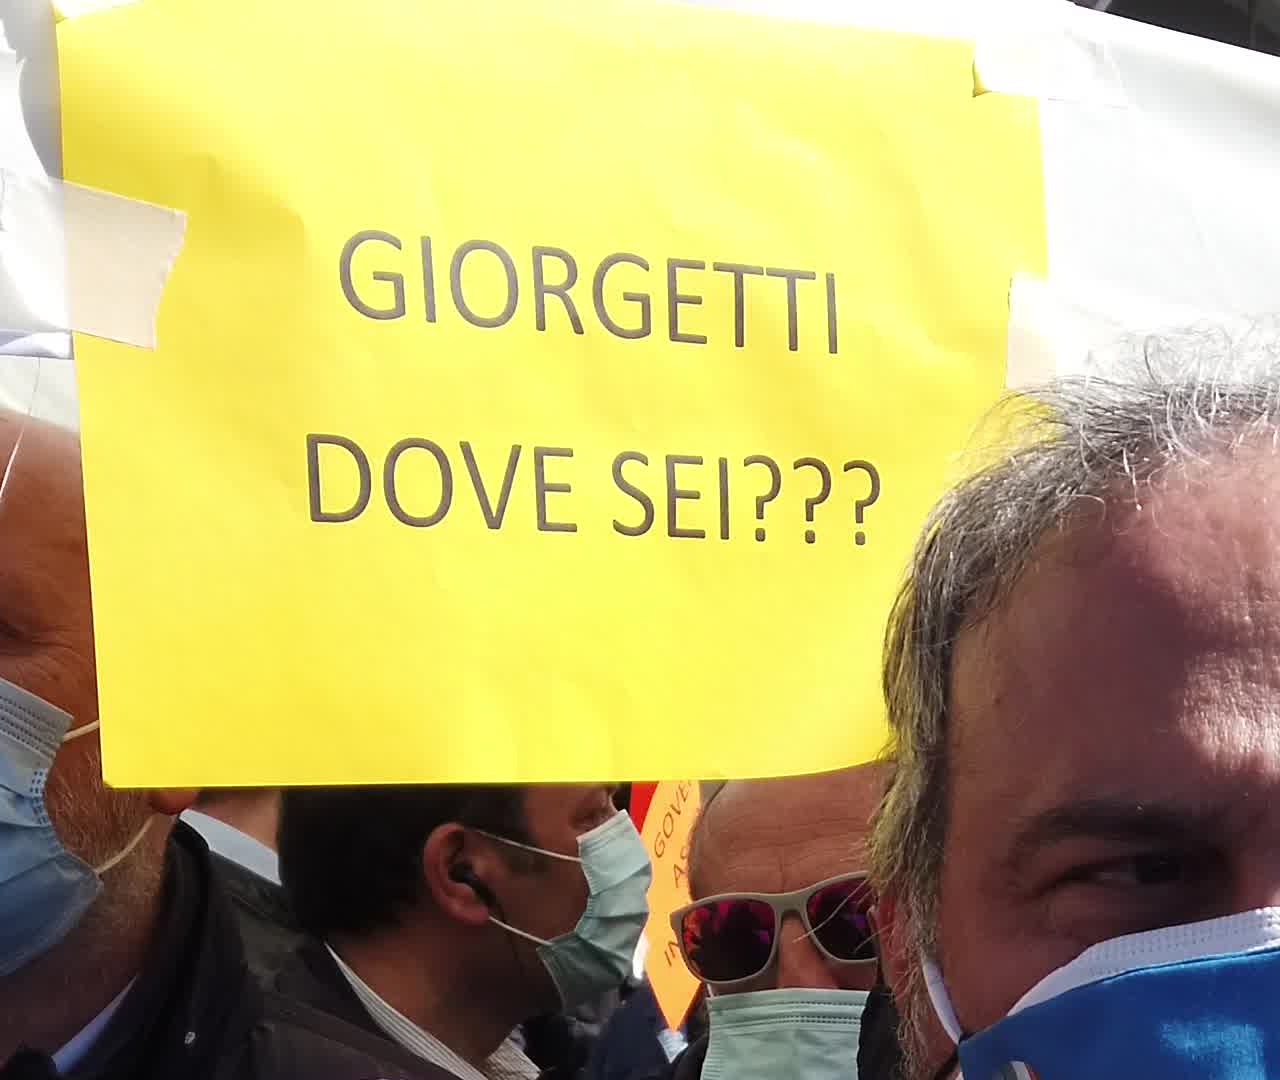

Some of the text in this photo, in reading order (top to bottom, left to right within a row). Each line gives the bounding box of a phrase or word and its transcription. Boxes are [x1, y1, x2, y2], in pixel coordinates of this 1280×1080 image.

[339, 229, 838, 354] GIORGETTI
[306, 433, 880, 546] DOVE SEI???
